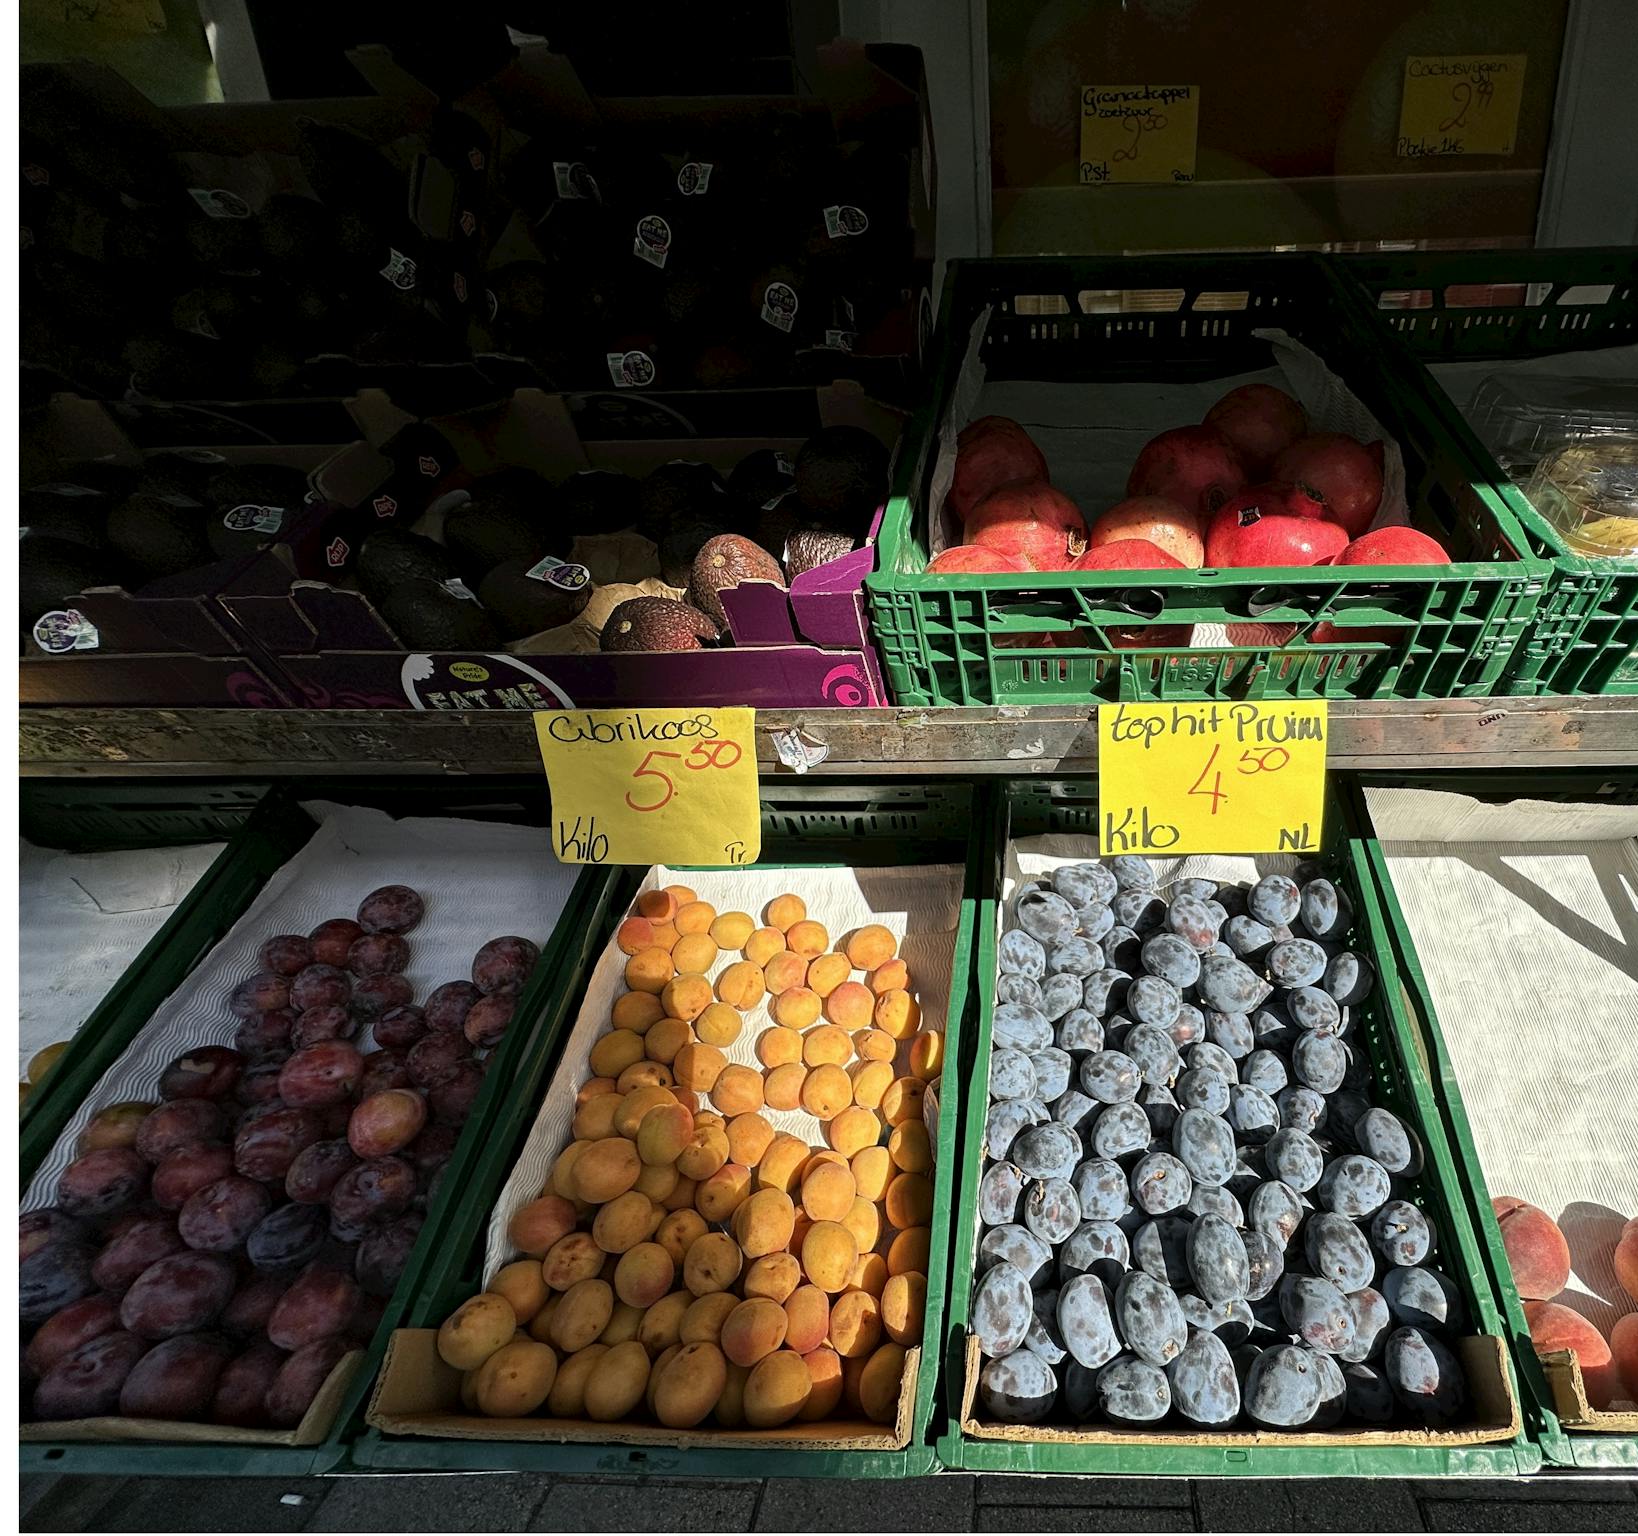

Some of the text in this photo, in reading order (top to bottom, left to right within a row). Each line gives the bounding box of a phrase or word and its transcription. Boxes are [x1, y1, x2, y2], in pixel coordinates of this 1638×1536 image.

[1229, 703, 1323, 744] Pruim
[560, 816, 609, 863] Kilo
[1106, 806, 1317, 853] Kilo NL
